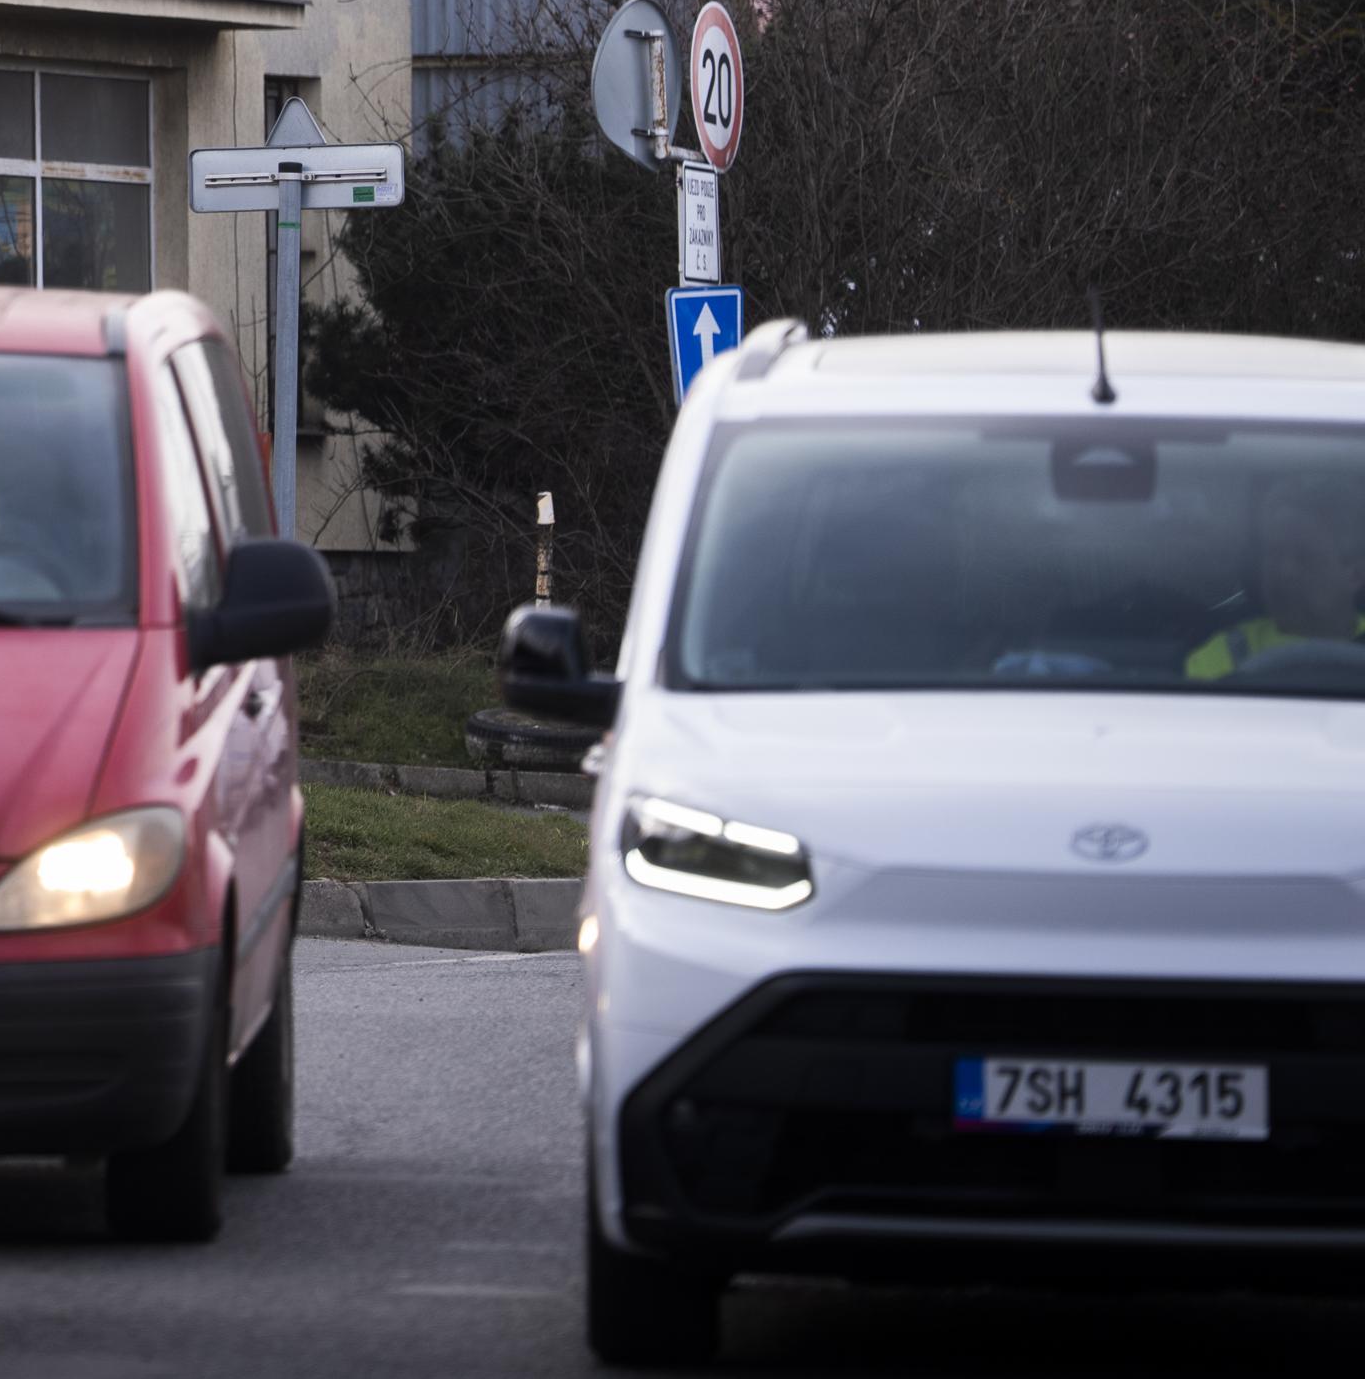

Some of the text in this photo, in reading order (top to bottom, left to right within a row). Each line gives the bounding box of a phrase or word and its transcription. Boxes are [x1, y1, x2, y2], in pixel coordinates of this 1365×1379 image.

[702, 48, 732, 129] 20
[996, 1066, 1245, 1120] 7SH 4315
